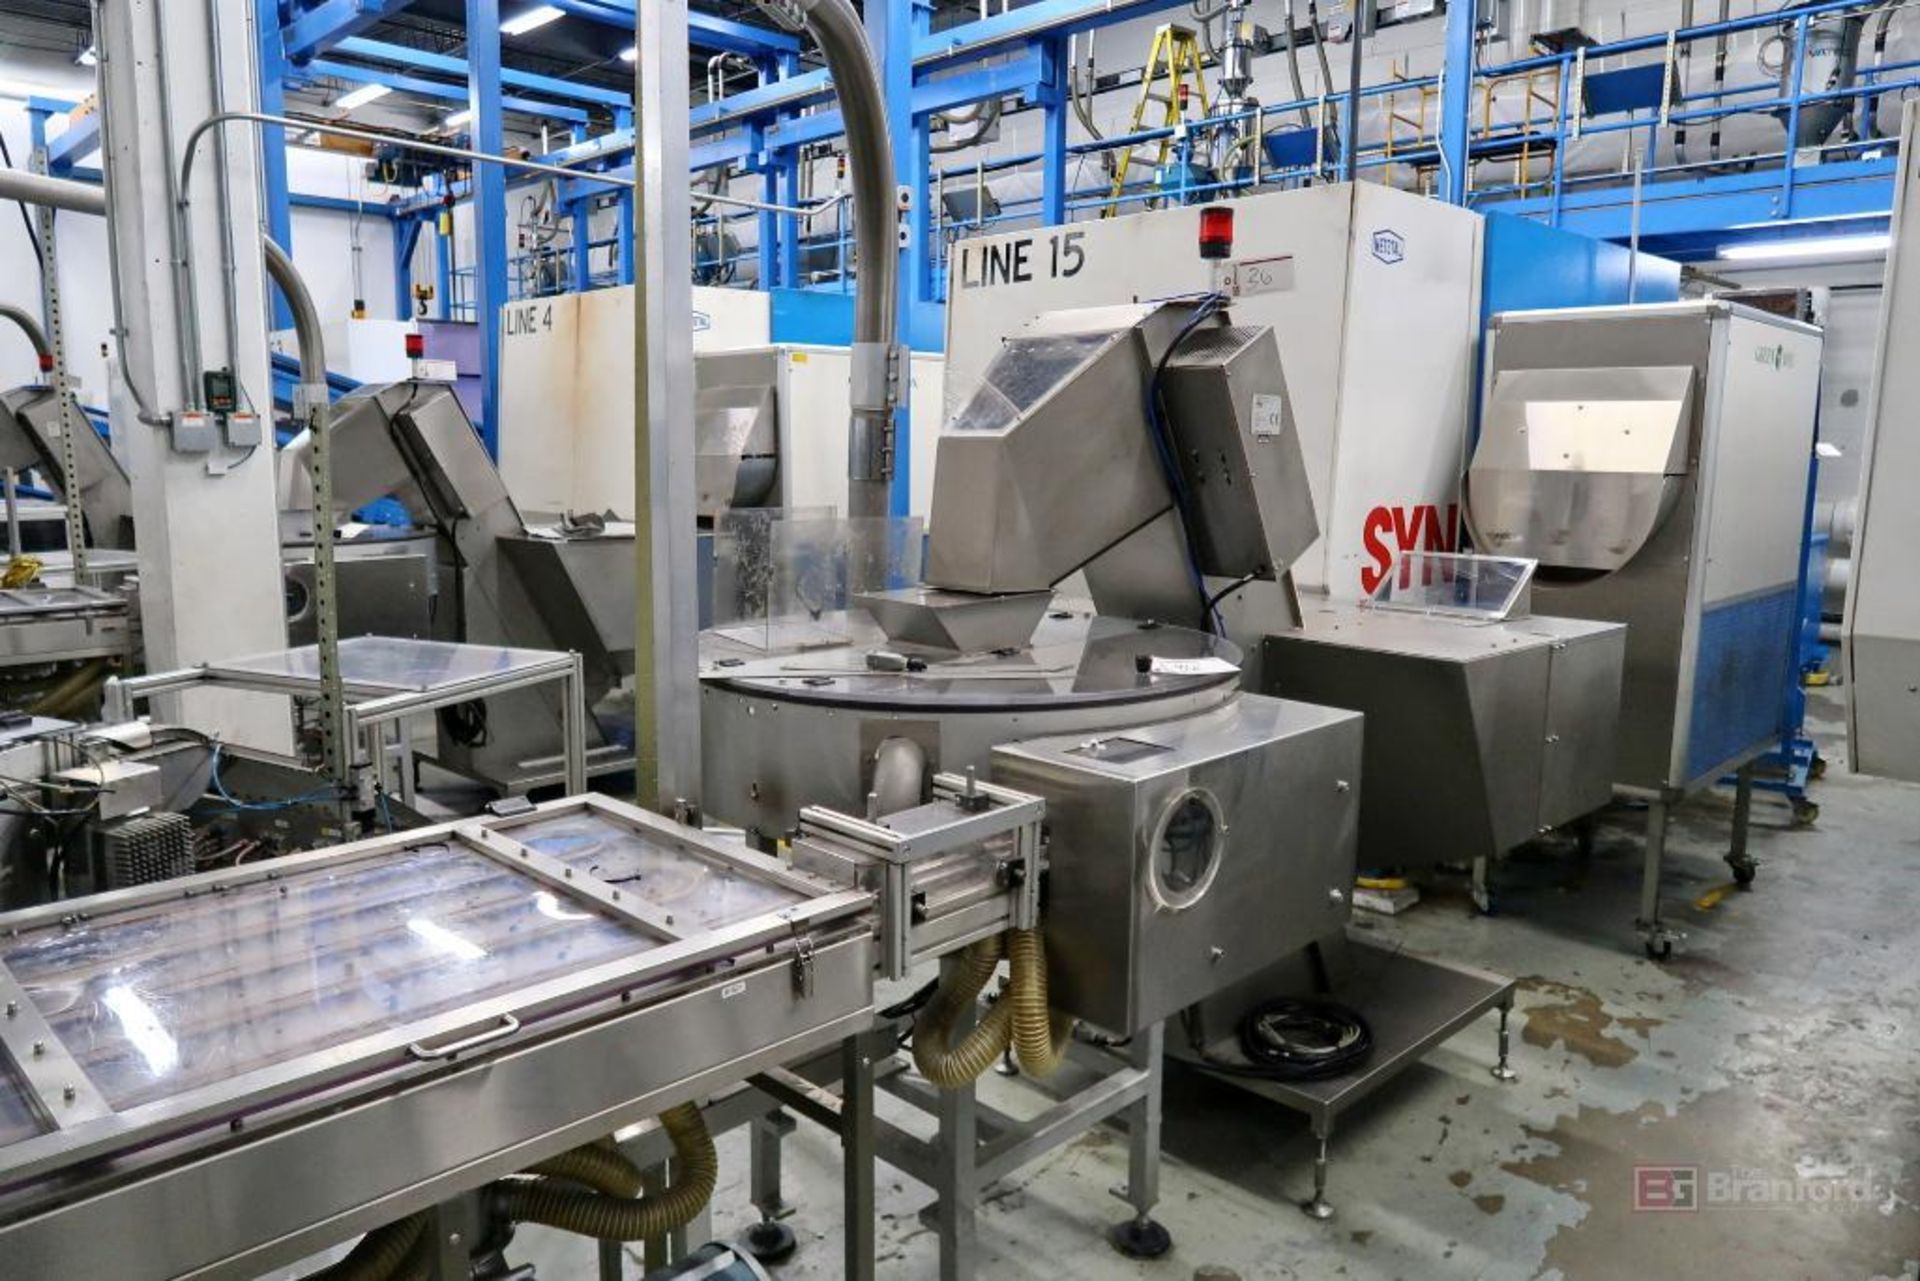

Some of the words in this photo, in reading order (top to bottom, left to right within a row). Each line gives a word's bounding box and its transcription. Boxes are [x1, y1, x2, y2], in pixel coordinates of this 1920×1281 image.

[962, 239, 1033, 288] LINE
[1050, 231, 1085, 278] 15
[507, 305, 537, 335] LINE
[542, 303, 552, 332] 4
